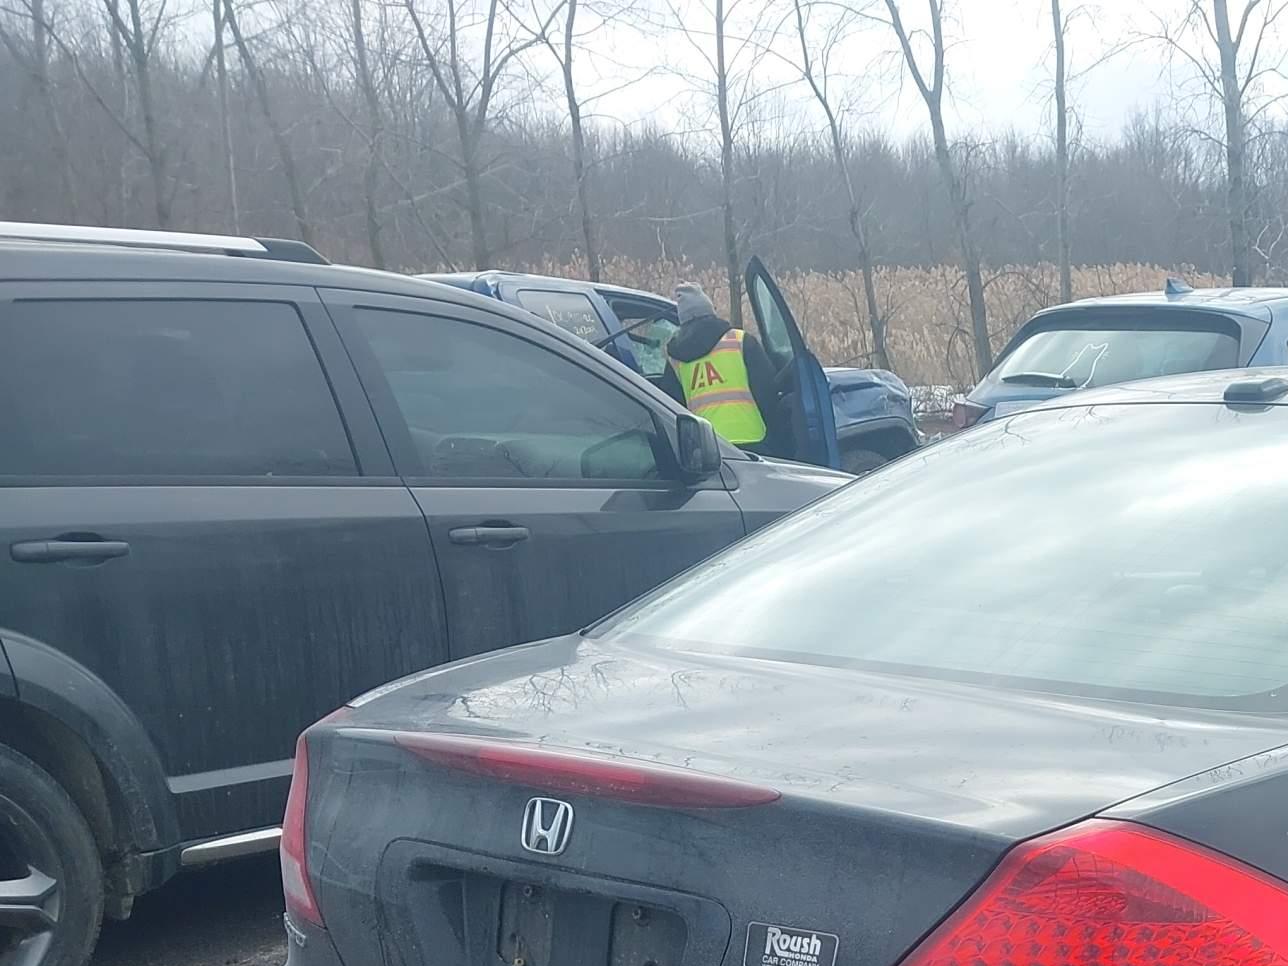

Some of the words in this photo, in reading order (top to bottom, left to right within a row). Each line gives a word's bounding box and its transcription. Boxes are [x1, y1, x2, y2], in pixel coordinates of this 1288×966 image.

[764, 927, 821, 957] Roush
[762, 955, 780, 964] CAR
[789, 953, 818, 963] HONDA
